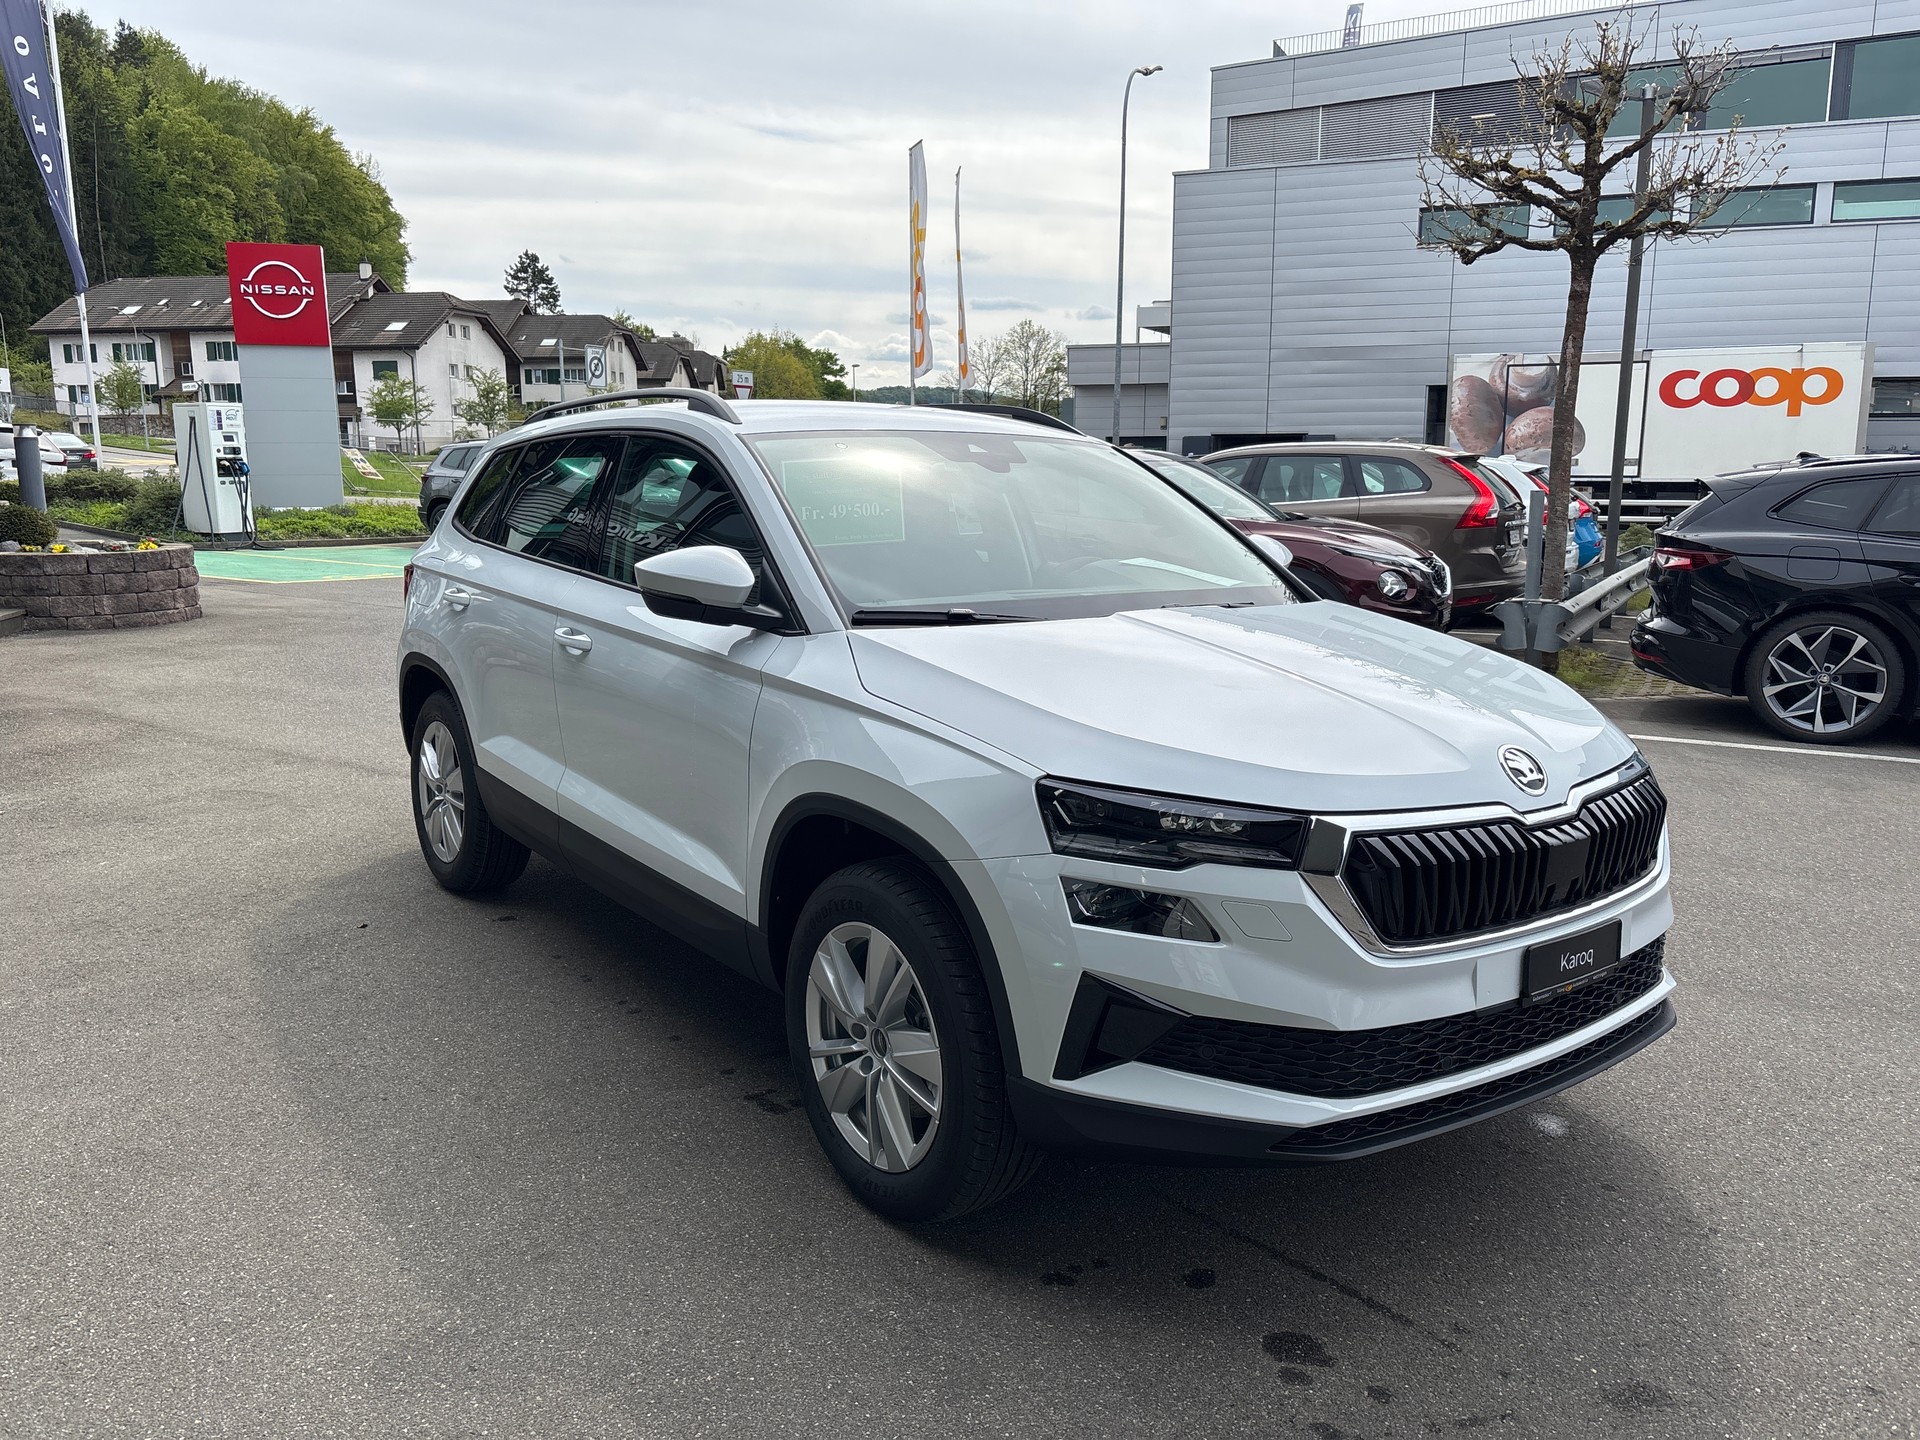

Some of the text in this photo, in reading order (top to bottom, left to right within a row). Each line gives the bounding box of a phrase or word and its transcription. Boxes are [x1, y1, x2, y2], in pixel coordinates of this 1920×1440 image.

[240, 284, 314, 295] NISSAN
[1659, 366, 1844, 417] coop
[801, 506, 824, 520] Fr.
[1560, 948, 1594, 972] Karoq
